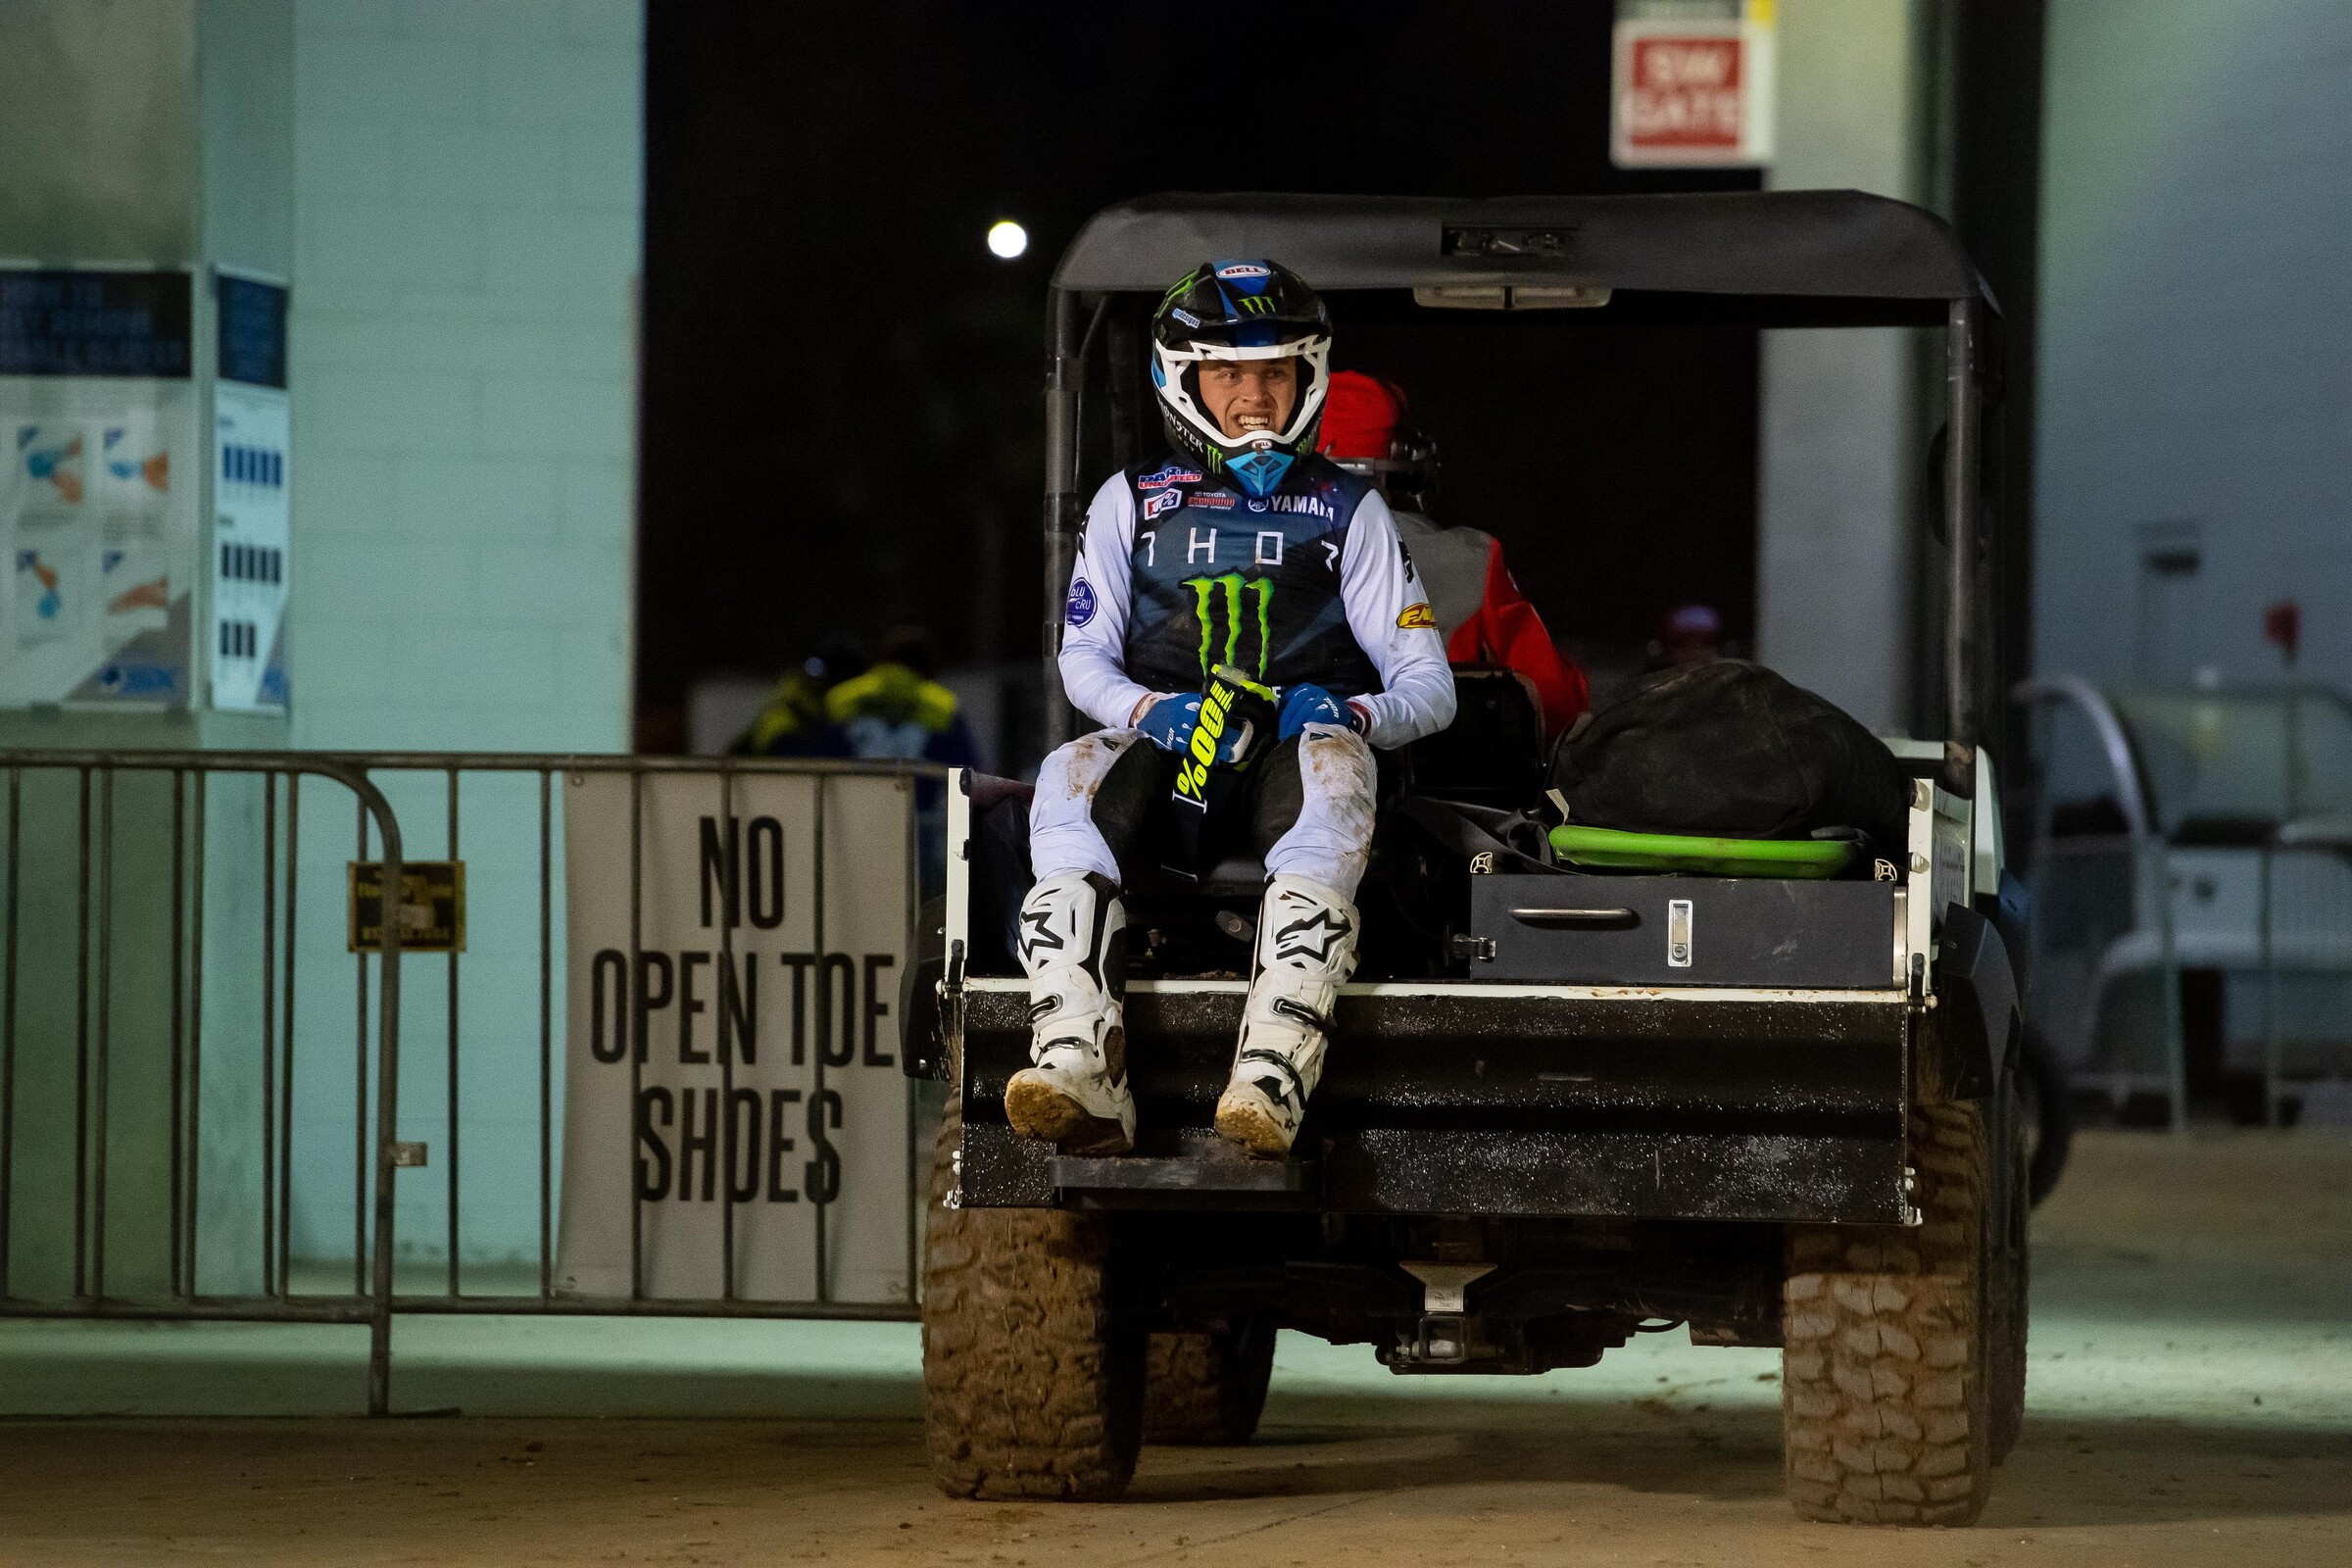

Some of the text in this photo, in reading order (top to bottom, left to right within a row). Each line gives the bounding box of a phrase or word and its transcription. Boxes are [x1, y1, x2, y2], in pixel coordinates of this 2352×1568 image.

[1225, 267, 1263, 275] BELL
[1176, 679, 1235, 801] 100%
[1323, 697, 1340, 719] THOR
[699, 815, 784, 930] NO
[590, 948, 895, 1067] OPEN TOE
[637, 1086, 843, 1203] SHOES
